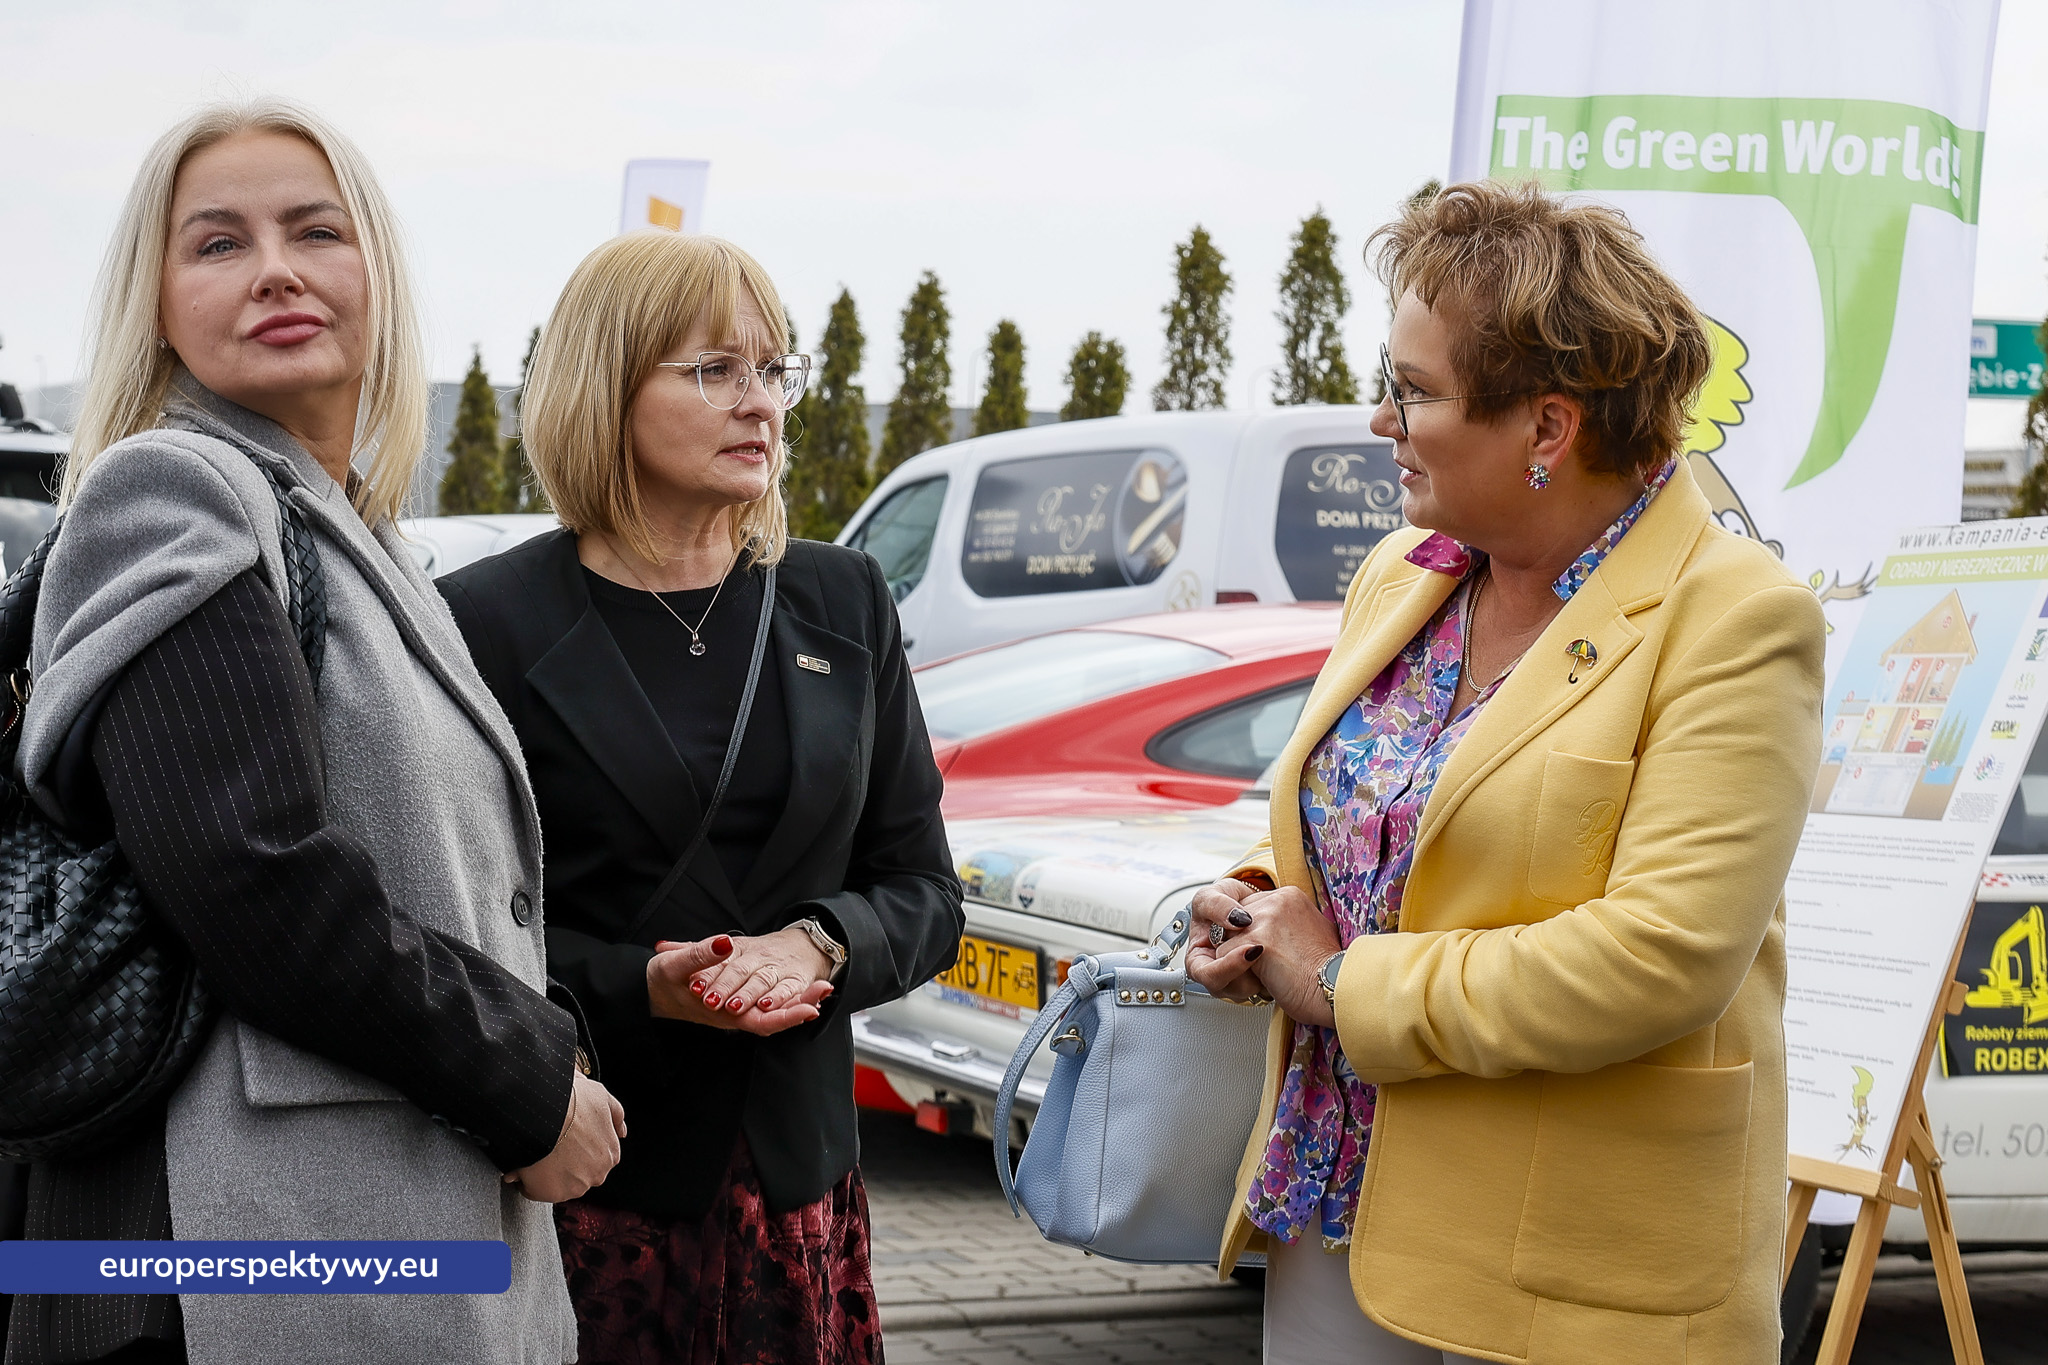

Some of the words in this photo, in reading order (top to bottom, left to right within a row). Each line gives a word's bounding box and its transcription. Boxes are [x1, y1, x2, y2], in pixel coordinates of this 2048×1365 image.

[1497, 115, 1589, 170] The
[1602, 116, 1768, 172] Green
[1781, 119, 1962, 199] World!
[1315, 509, 1360, 529] DOM
[1888, 559, 1940, 580] ODPADY
[1938, 555, 2033, 577] NIEBEZPIECZNE
[1964, 1024, 2014, 1044] Roboty
[1974, 1047, 2048, 1072] ROBEX
[1941, 1122, 1990, 1158] tel.
